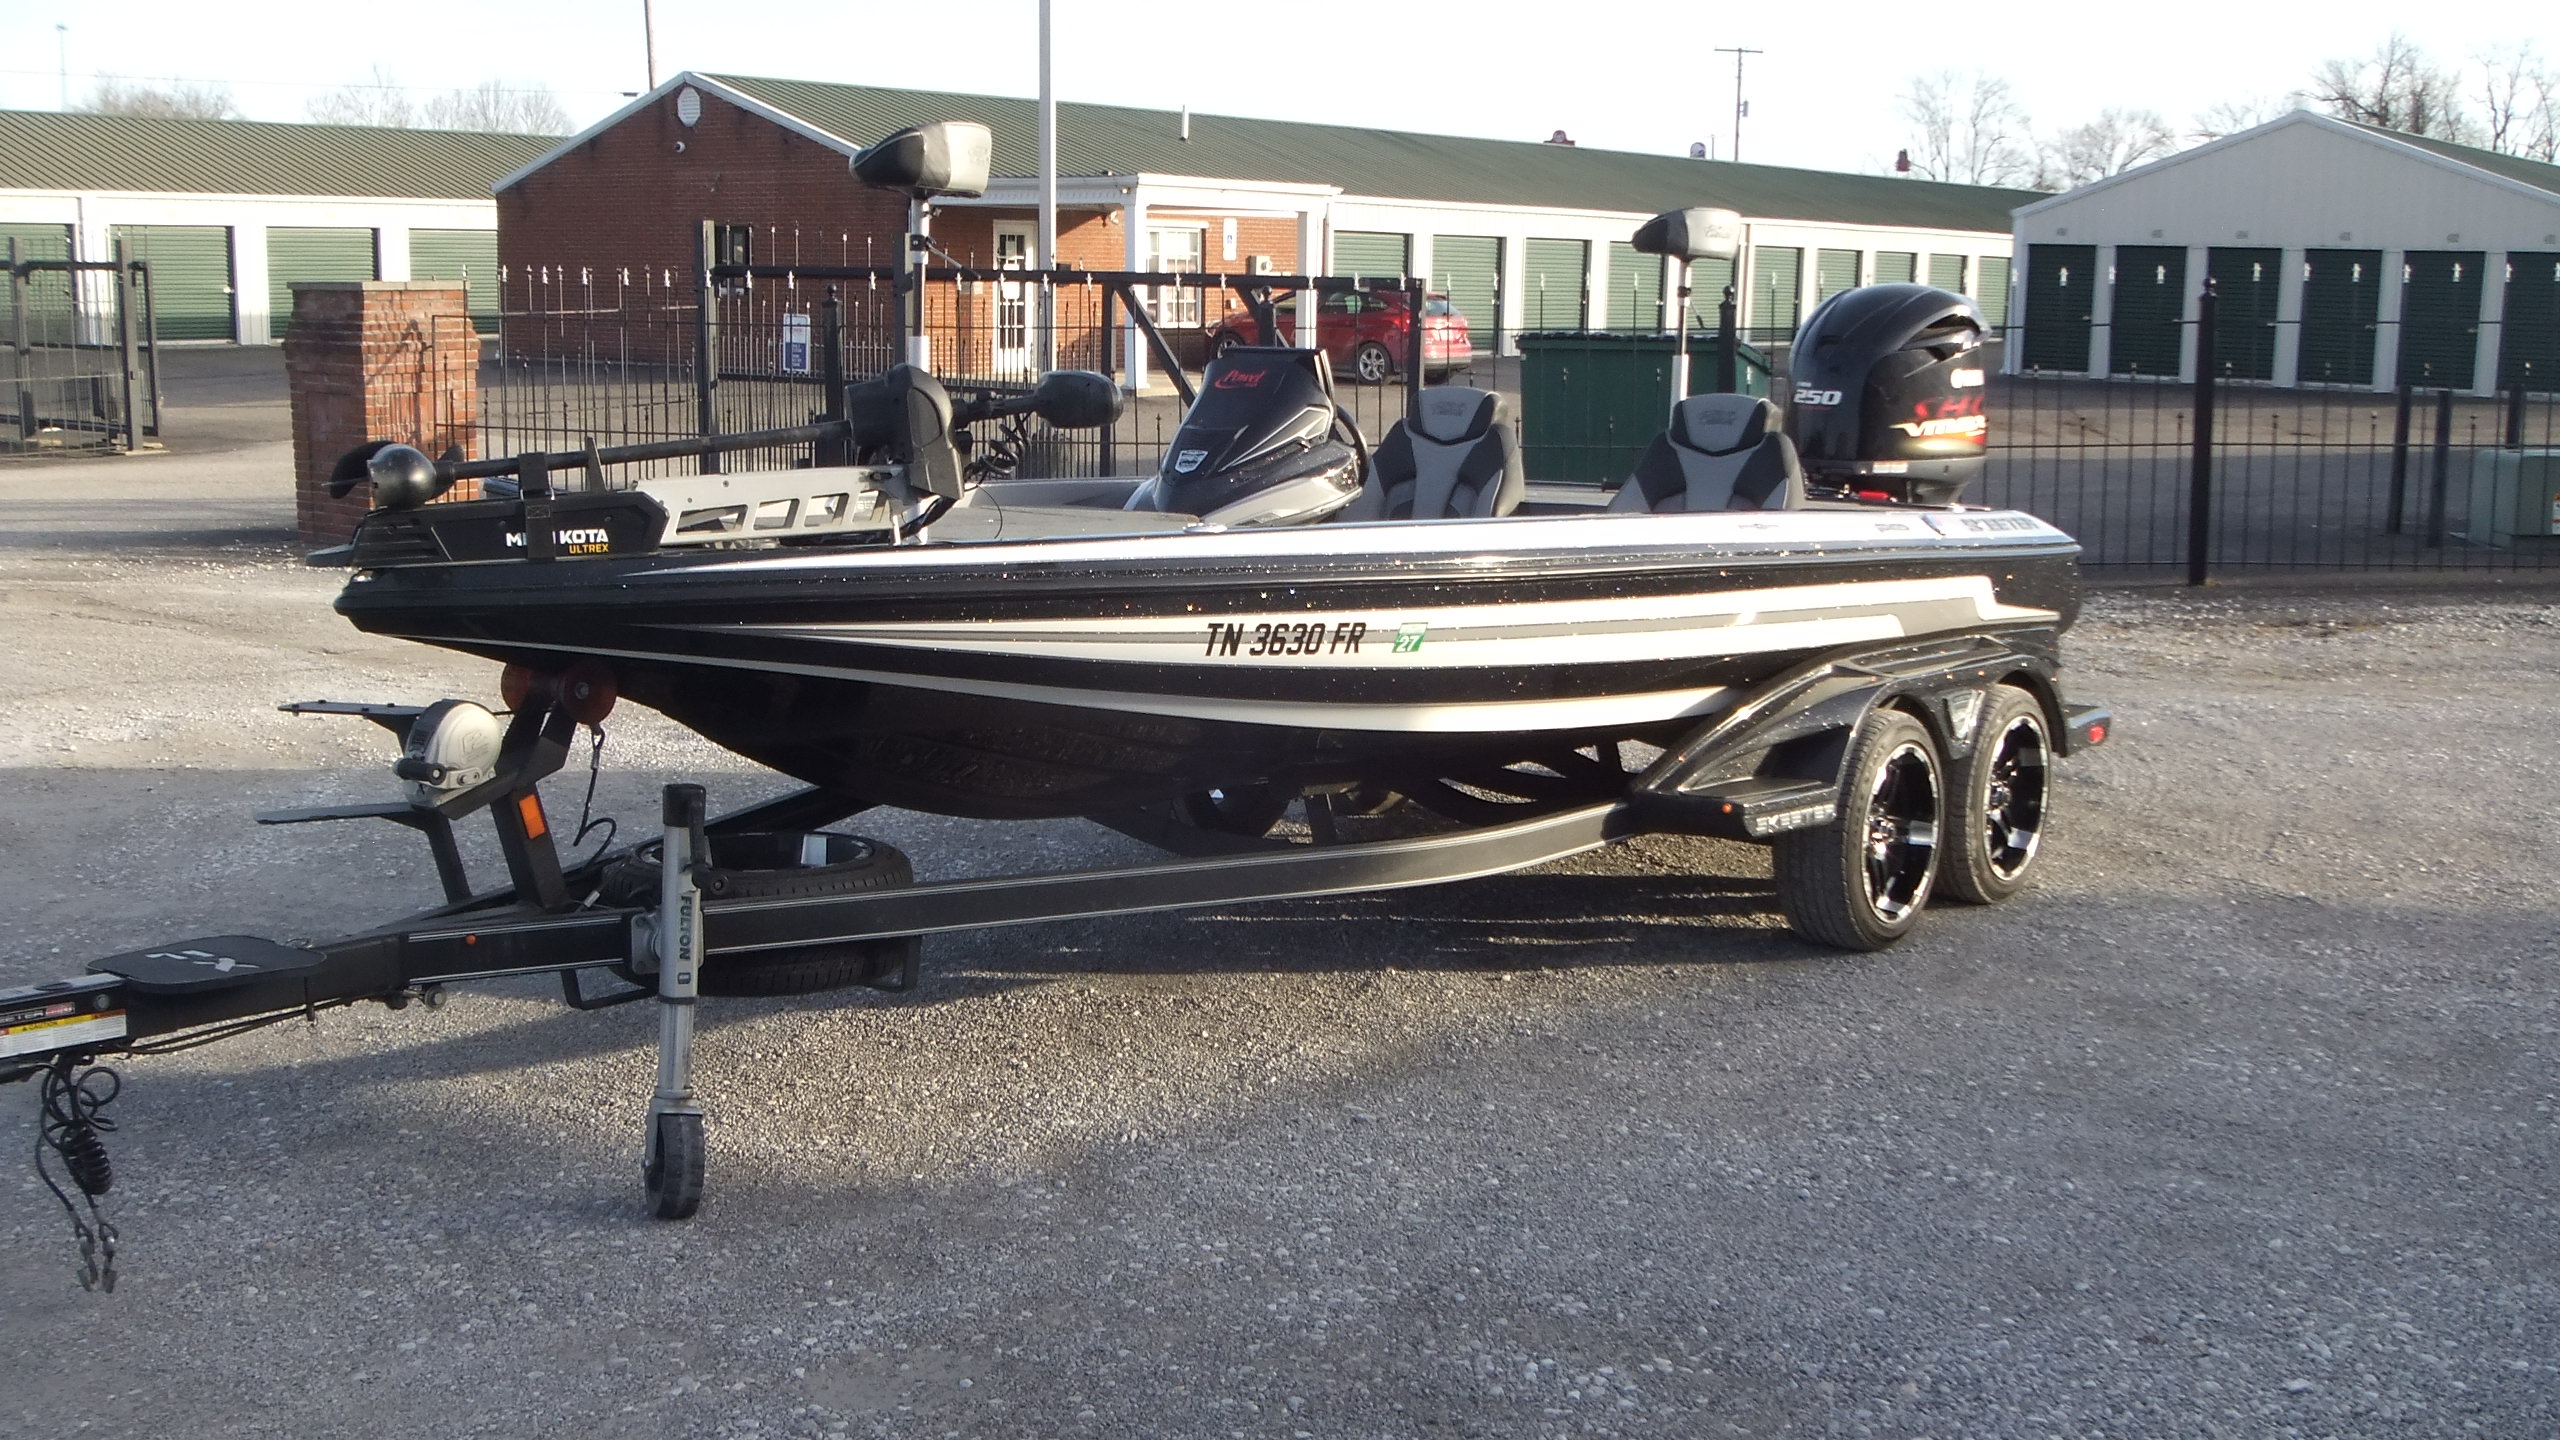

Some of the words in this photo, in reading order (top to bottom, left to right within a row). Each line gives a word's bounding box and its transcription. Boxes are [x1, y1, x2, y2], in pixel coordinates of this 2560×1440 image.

[1793, 389, 1842, 406] 250
[560, 528, 609, 545] KOTA
[569, 543, 609, 554] ULTREX
[1205, 622, 1245, 657] TN
[1248, 622, 1326, 656] 3630
[1329, 621, 1367, 655] FR
[1396, 634, 1421, 652] 27
[679, 895, 693, 960] FULTON
